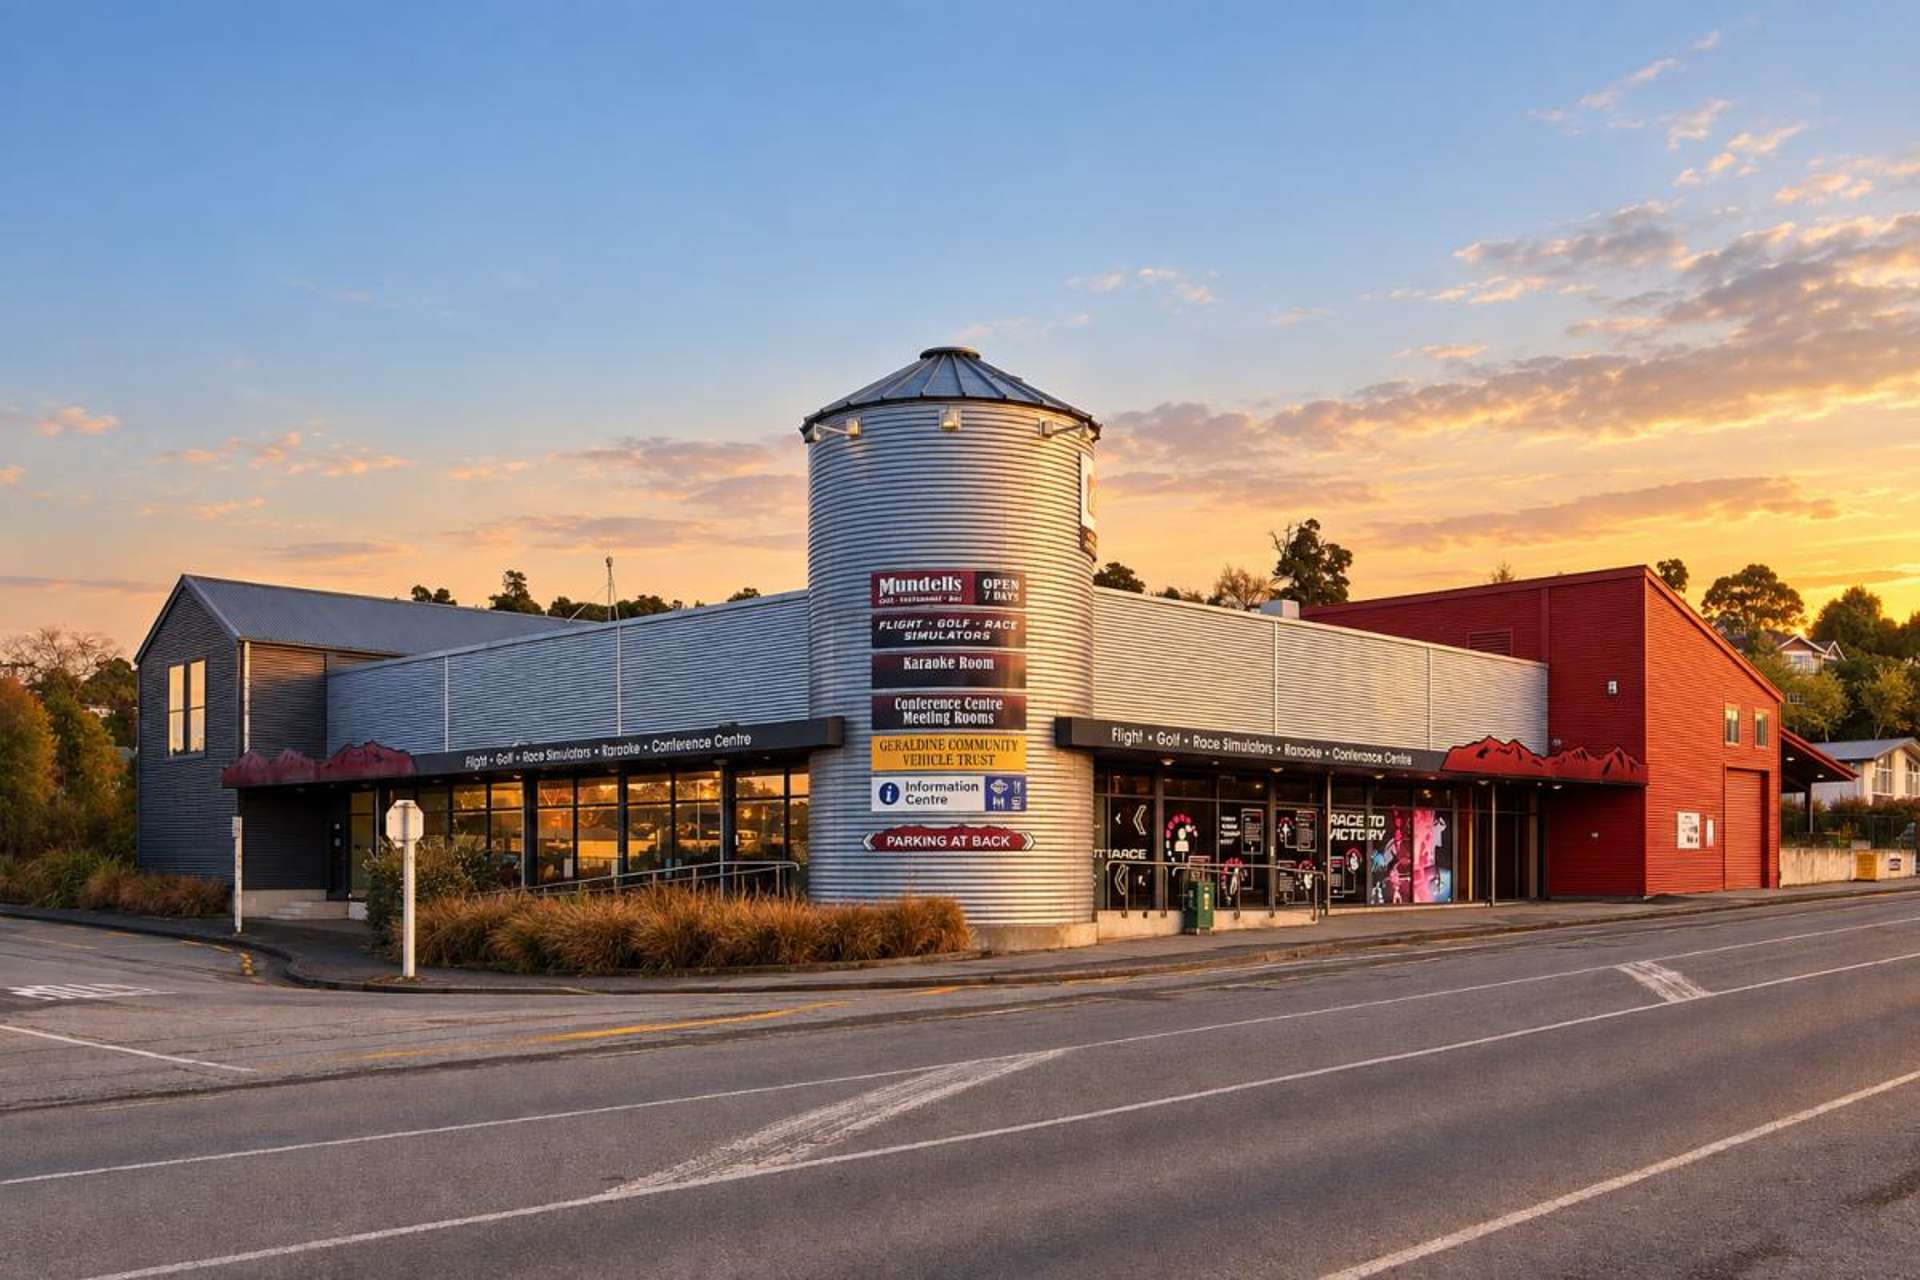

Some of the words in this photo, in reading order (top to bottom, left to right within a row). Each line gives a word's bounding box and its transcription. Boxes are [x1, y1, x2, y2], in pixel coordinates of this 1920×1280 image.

[879, 576, 962, 597] Mundells
[983, 578, 1020, 590] OPEN
[984, 591, 991, 601] 7
[993, 591, 1019, 602] DAYS
[879, 620, 922, 630] FLIGHT
[937, 619, 970, 629] GOLF
[984, 620, 1018, 630] RACE
[904, 631, 990, 641] SIMULATORS
[903, 657, 955, 670] Karaoke
[959, 656, 994, 670] Room
[895, 696, 961, 710] Conference
[964, 697, 1003, 710] Centre
[903, 711, 950, 726] Meeting
[954, 712, 994, 725] Rooms
[546, 747, 592, 761] Simulators
[651, 737, 712, 753] Conference
[714, 733, 752, 748] Centre
[880, 738, 945, 751] GERALDINE
[948, 738, 1018, 752] COMMUNITY
[1111, 727, 1144, 747] Flight
[1156, 731, 1181, 746] Golf
[1192, 735, 1221, 750] Race
[1222, 738, 1274, 755] Simulators
[1331, 747, 1383, 763] Conference
[1384, 751, 1413, 766] Centre
[903, 755, 954, 766] VEHICLE
[957, 754, 996, 766] TRUST
[905, 780, 979, 793] Information
[905, 794, 948, 806] Centre
[1330, 814, 1365, 827] RACE
[1368, 815, 1385, 828] TO
[886, 835, 947, 847] PARKING
[951, 835, 969, 847] AT
[972, 835, 1011, 847] BACK
